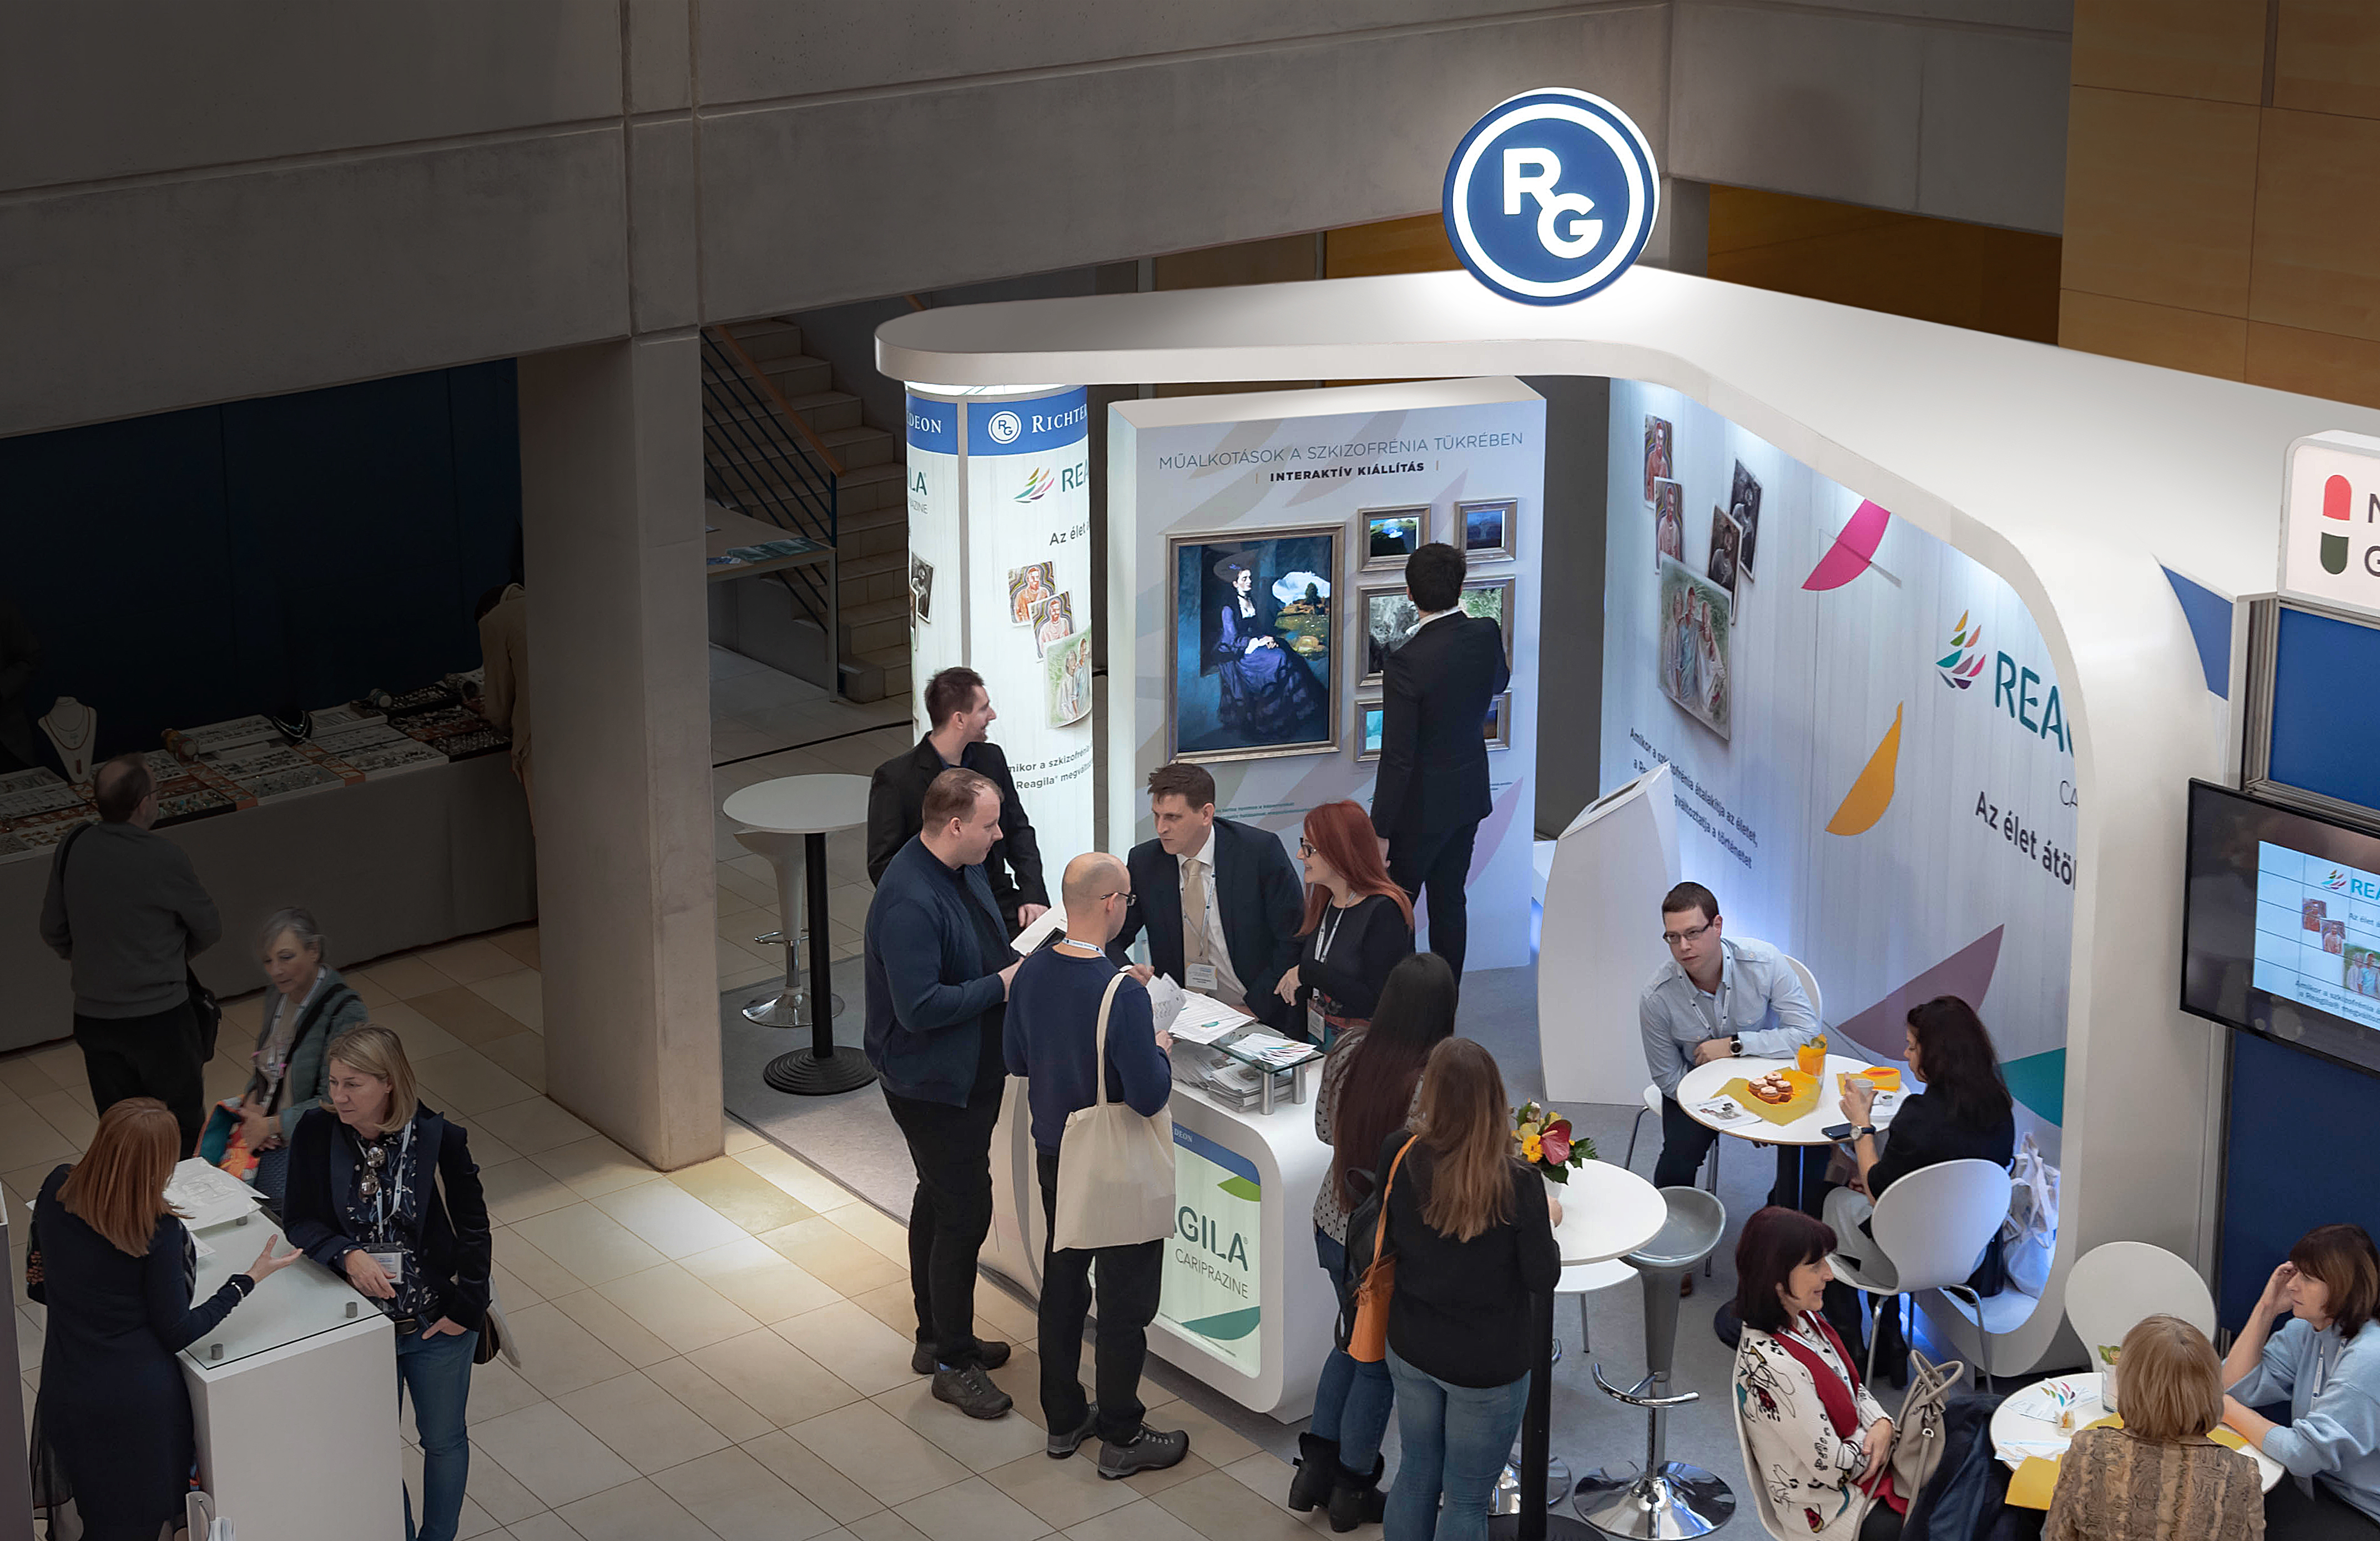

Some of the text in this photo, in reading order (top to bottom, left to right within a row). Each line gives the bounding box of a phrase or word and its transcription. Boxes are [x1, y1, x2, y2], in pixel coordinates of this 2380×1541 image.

[1503, 147, 1603, 259] RG
[998, 420, 1013, 436] RG
[1159, 432, 1523, 470] MŰALKOTÁSOK A SZKIZOFRÉNIA TÜKRÉBEN
[1270, 461, 1424, 482] INTERAKTÍV KIÁLLÍTÁS
[1049, 532, 1067, 546] Az
[1995, 650, 2074, 758] REA
[1007, 763, 1036, 773] mikor
[1975, 790, 1998, 830] Az
[2004, 810, 2038, 860] élet
[1175, 1248, 1248, 1300] CARIPRAZINE
